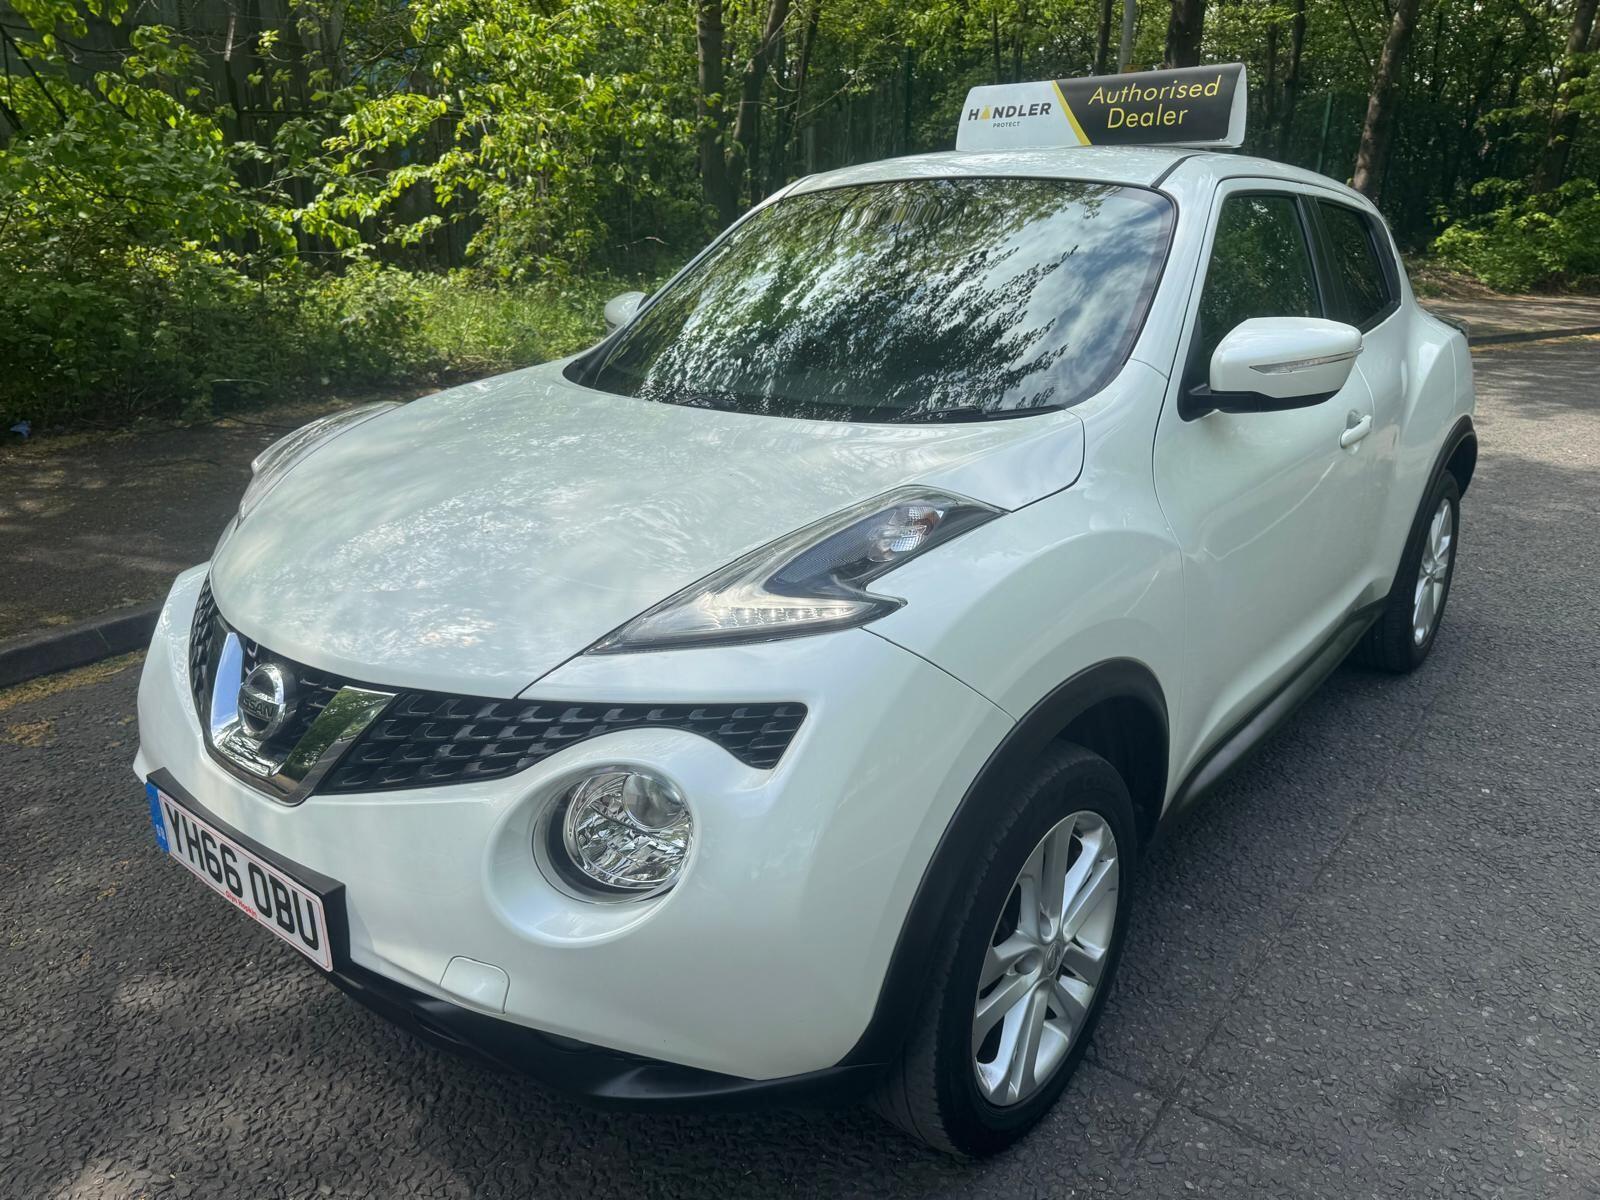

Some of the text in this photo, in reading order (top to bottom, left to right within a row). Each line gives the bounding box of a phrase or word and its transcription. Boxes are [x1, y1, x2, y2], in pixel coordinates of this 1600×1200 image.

[1088, 74, 1222, 105] Authorised
[968, 102, 1051, 121] HANDLER
[1107, 104, 1188, 129] Dealer
[165, 802, 319, 951] YH66 OBU
